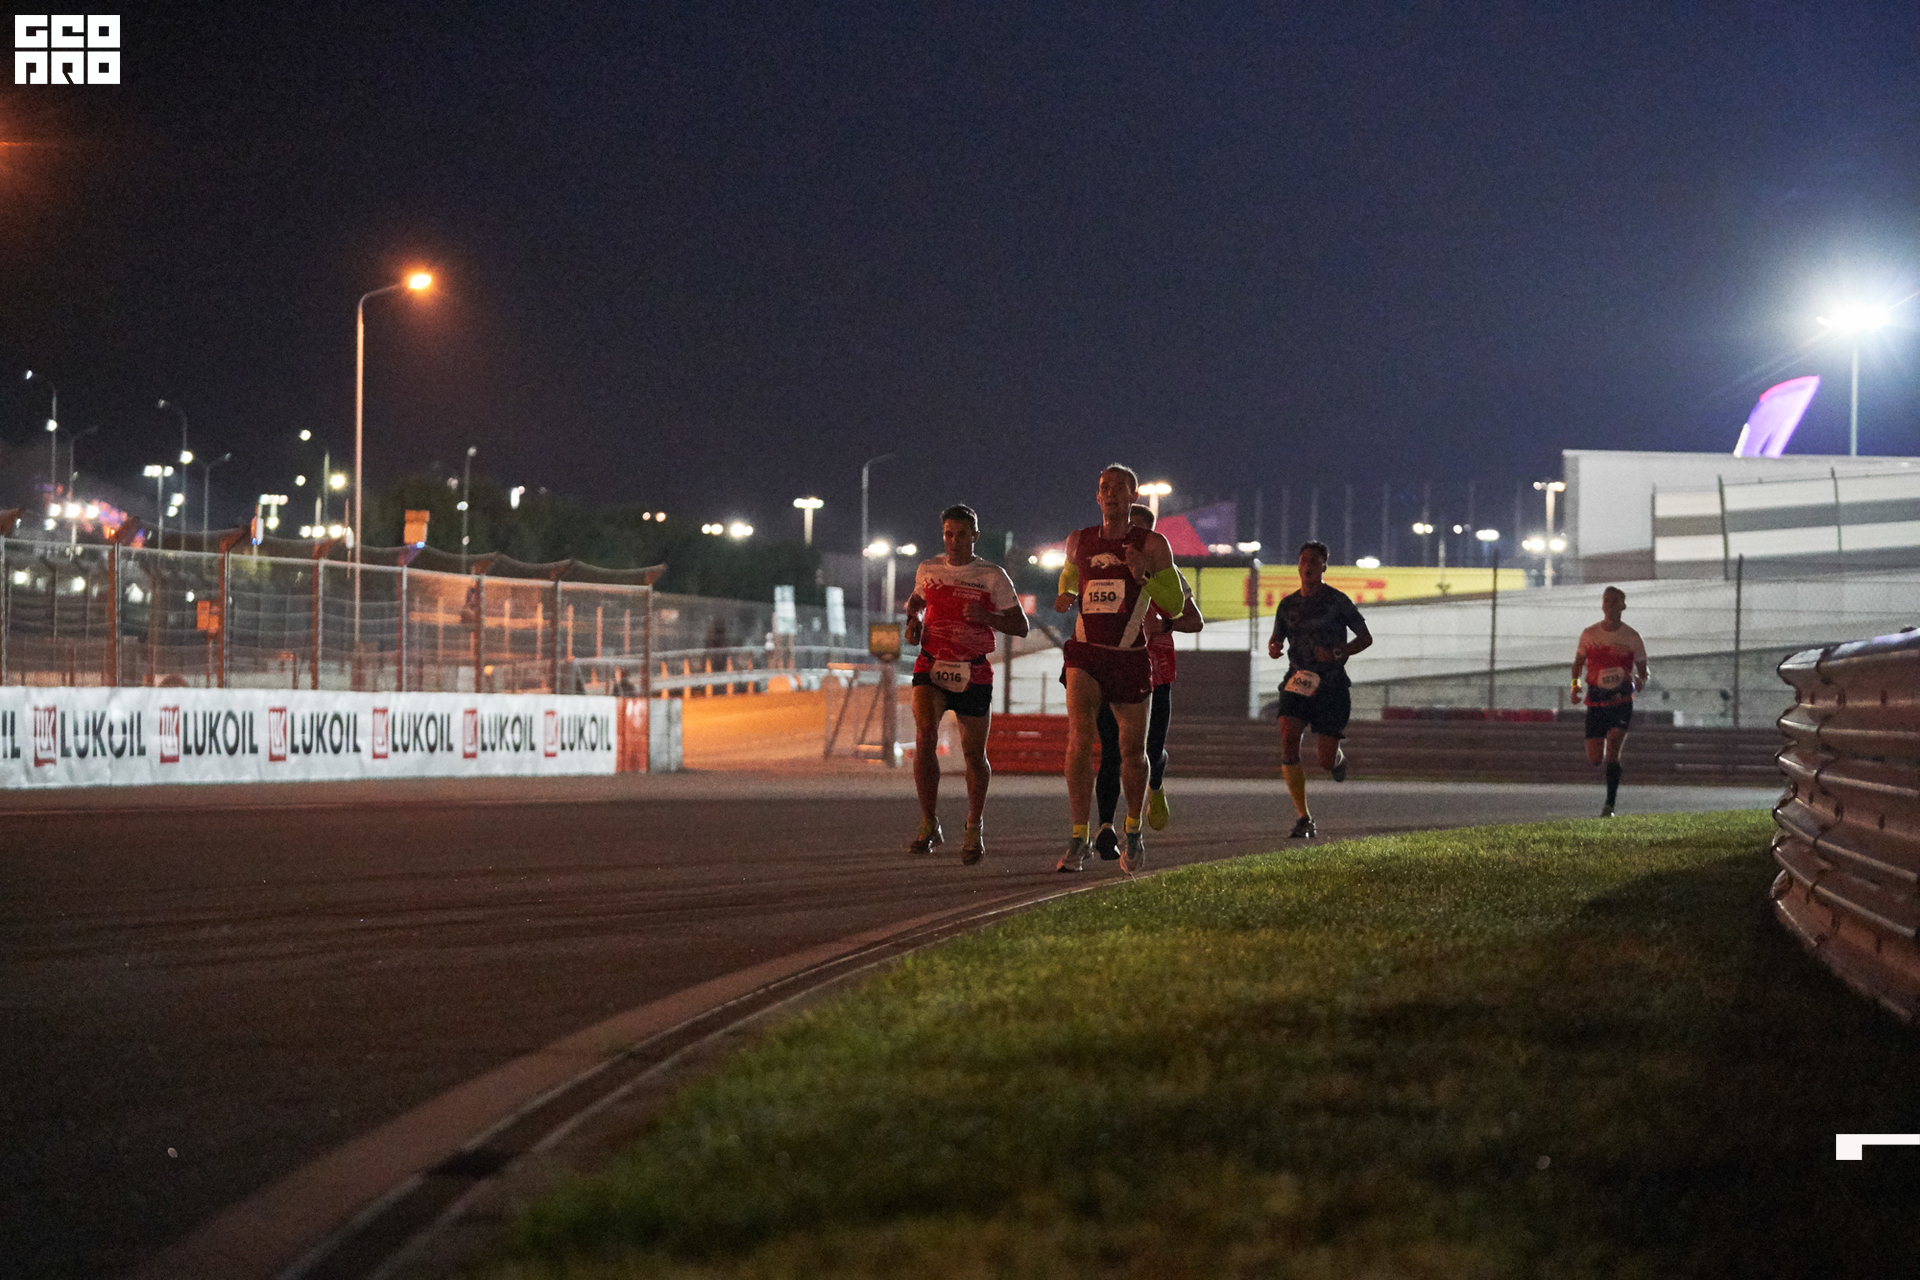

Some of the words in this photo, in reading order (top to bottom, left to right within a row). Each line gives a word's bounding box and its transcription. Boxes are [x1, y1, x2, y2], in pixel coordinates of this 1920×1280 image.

[1089, 591, 1116, 602] 1550
[936, 670, 962, 683] 1016
[60, 709, 146, 759] LUKOIL
[183, 708, 259, 756] LUKOIL
[290, 712, 361, 755] LUKOIL
[392, 712, 453, 753] LUKOIL
[480, 712, 536, 752] LUKOIL
[560, 714, 612, 751] LUKOIL
